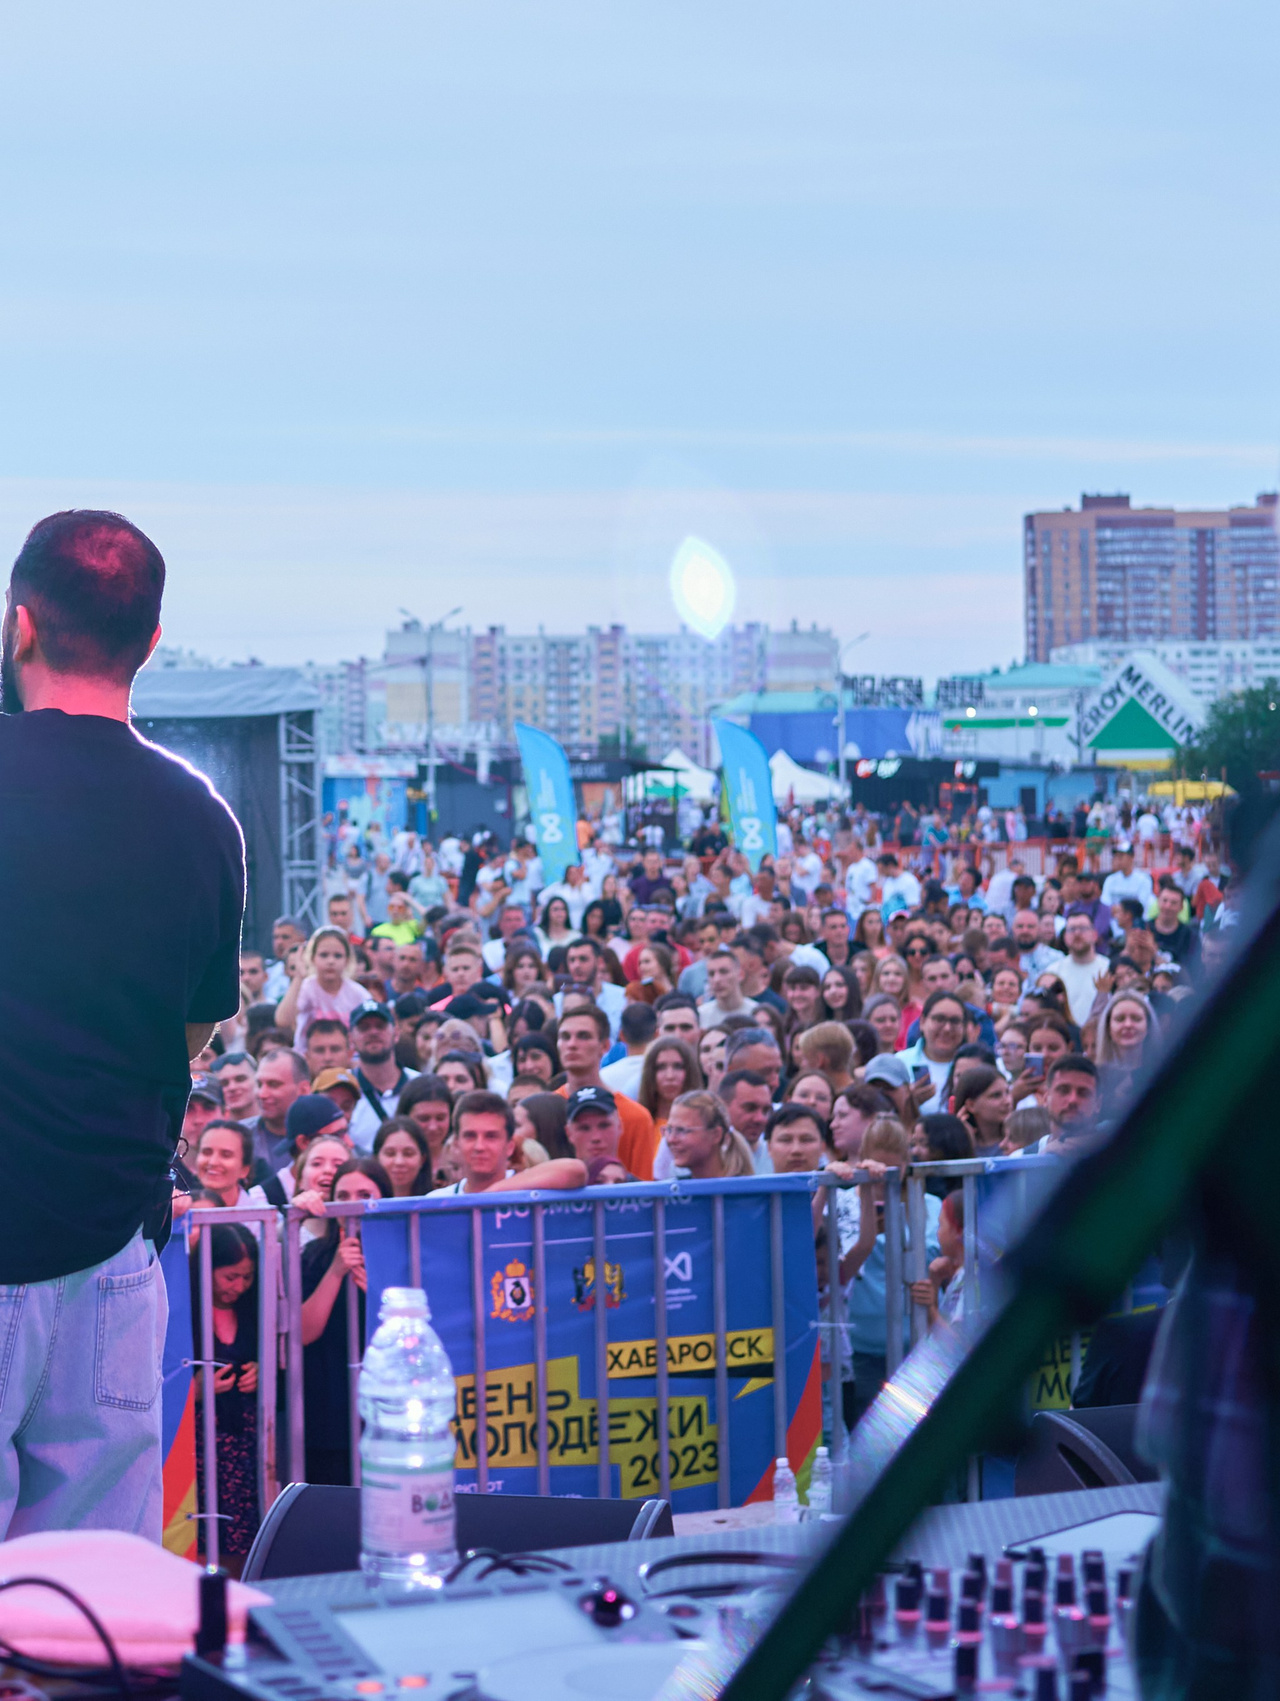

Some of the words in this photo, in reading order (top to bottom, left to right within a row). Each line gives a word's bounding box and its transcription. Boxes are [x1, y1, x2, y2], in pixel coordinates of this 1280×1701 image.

[1067, 680, 1125, 748] LEROY
[1122, 664, 1201, 748] MERLIN
[608, 1335, 764, 1371] ХАБАРОСК
[454, 1380, 571, 1427] ЕНЬ
[630, 1441, 718, 1488] 2023
